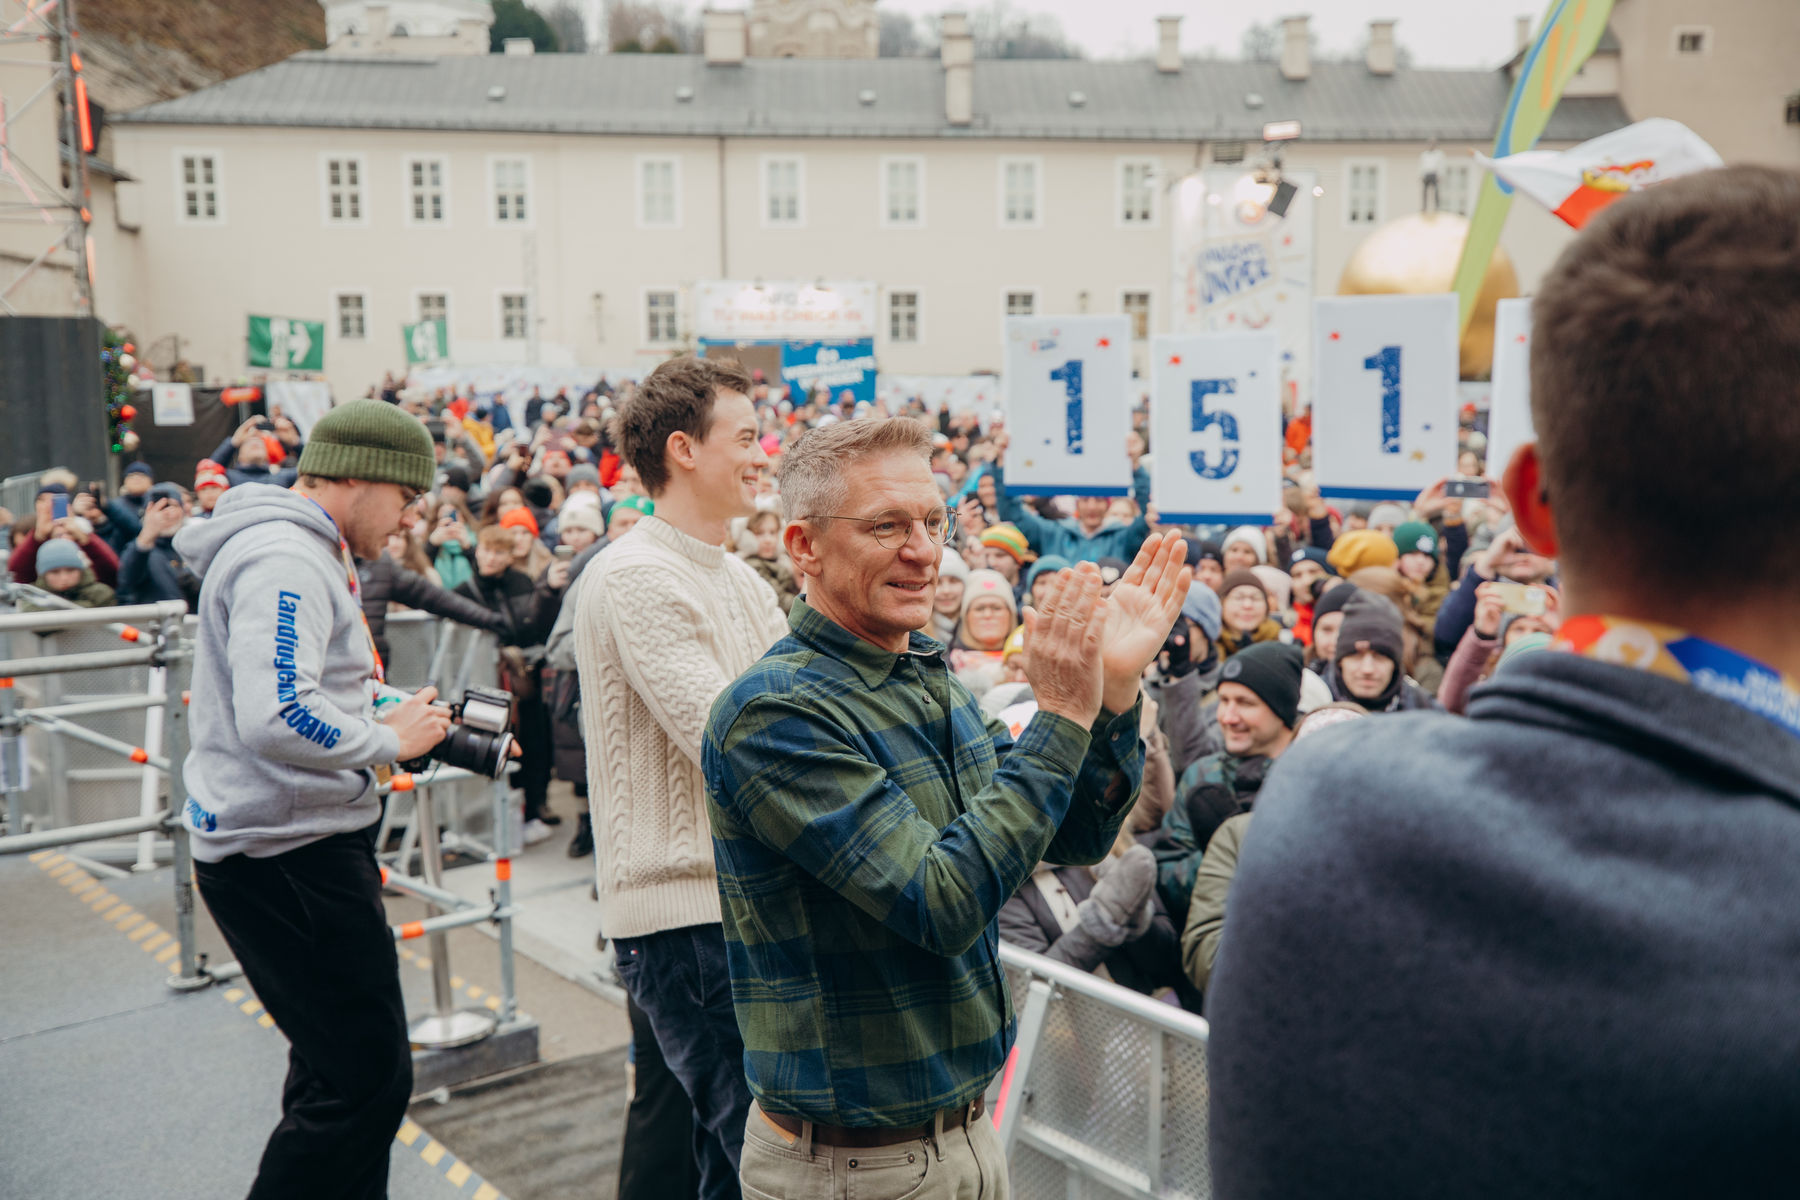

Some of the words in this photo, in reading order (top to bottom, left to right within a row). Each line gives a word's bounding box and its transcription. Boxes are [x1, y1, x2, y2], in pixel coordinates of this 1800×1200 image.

[1050, 360, 1083, 455] 1
[1189, 378, 1240, 480] 5
[1364, 346, 1402, 454] 1
